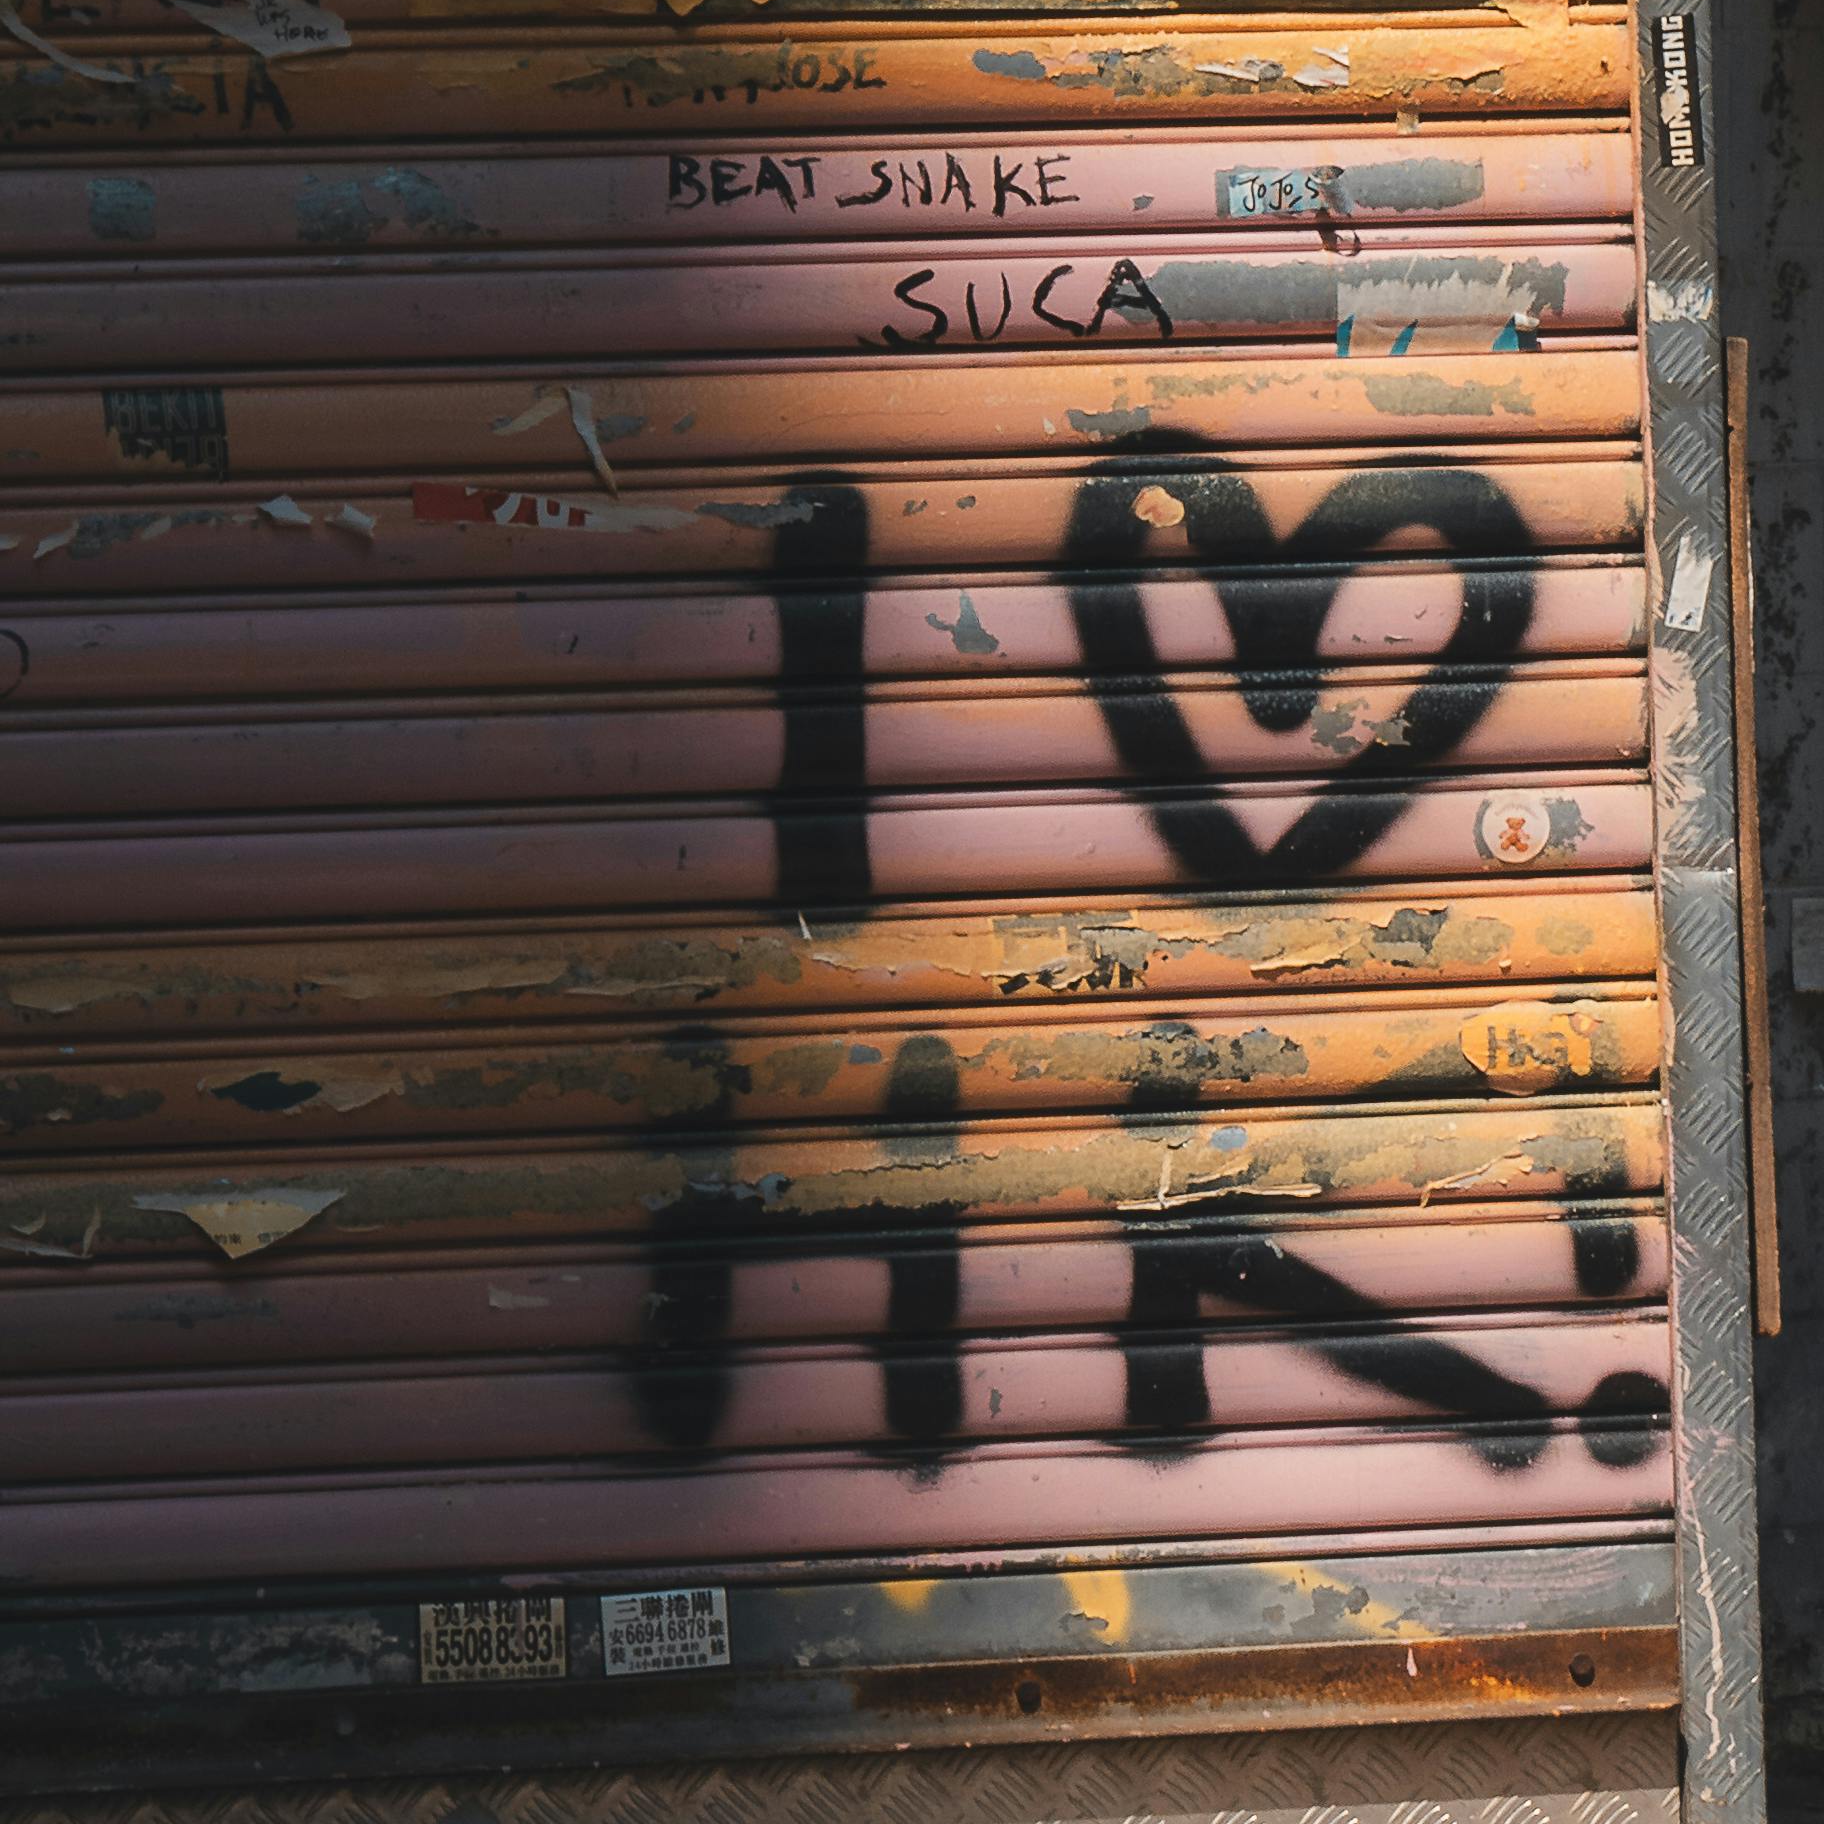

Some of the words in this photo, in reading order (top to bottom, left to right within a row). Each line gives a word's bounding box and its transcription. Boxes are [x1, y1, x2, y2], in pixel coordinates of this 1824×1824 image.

[1662, 89, 1695, 167] HON
[666, 152, 823, 215] BEAT
[836, 151, 1082, 218] SNAKE
[858, 257, 1175, 349] SUCA
[435, 1627, 493, 1668] 5508
[626, 1619, 664, 1647] 6694
[667, 1617, 706, 1642] 6878
